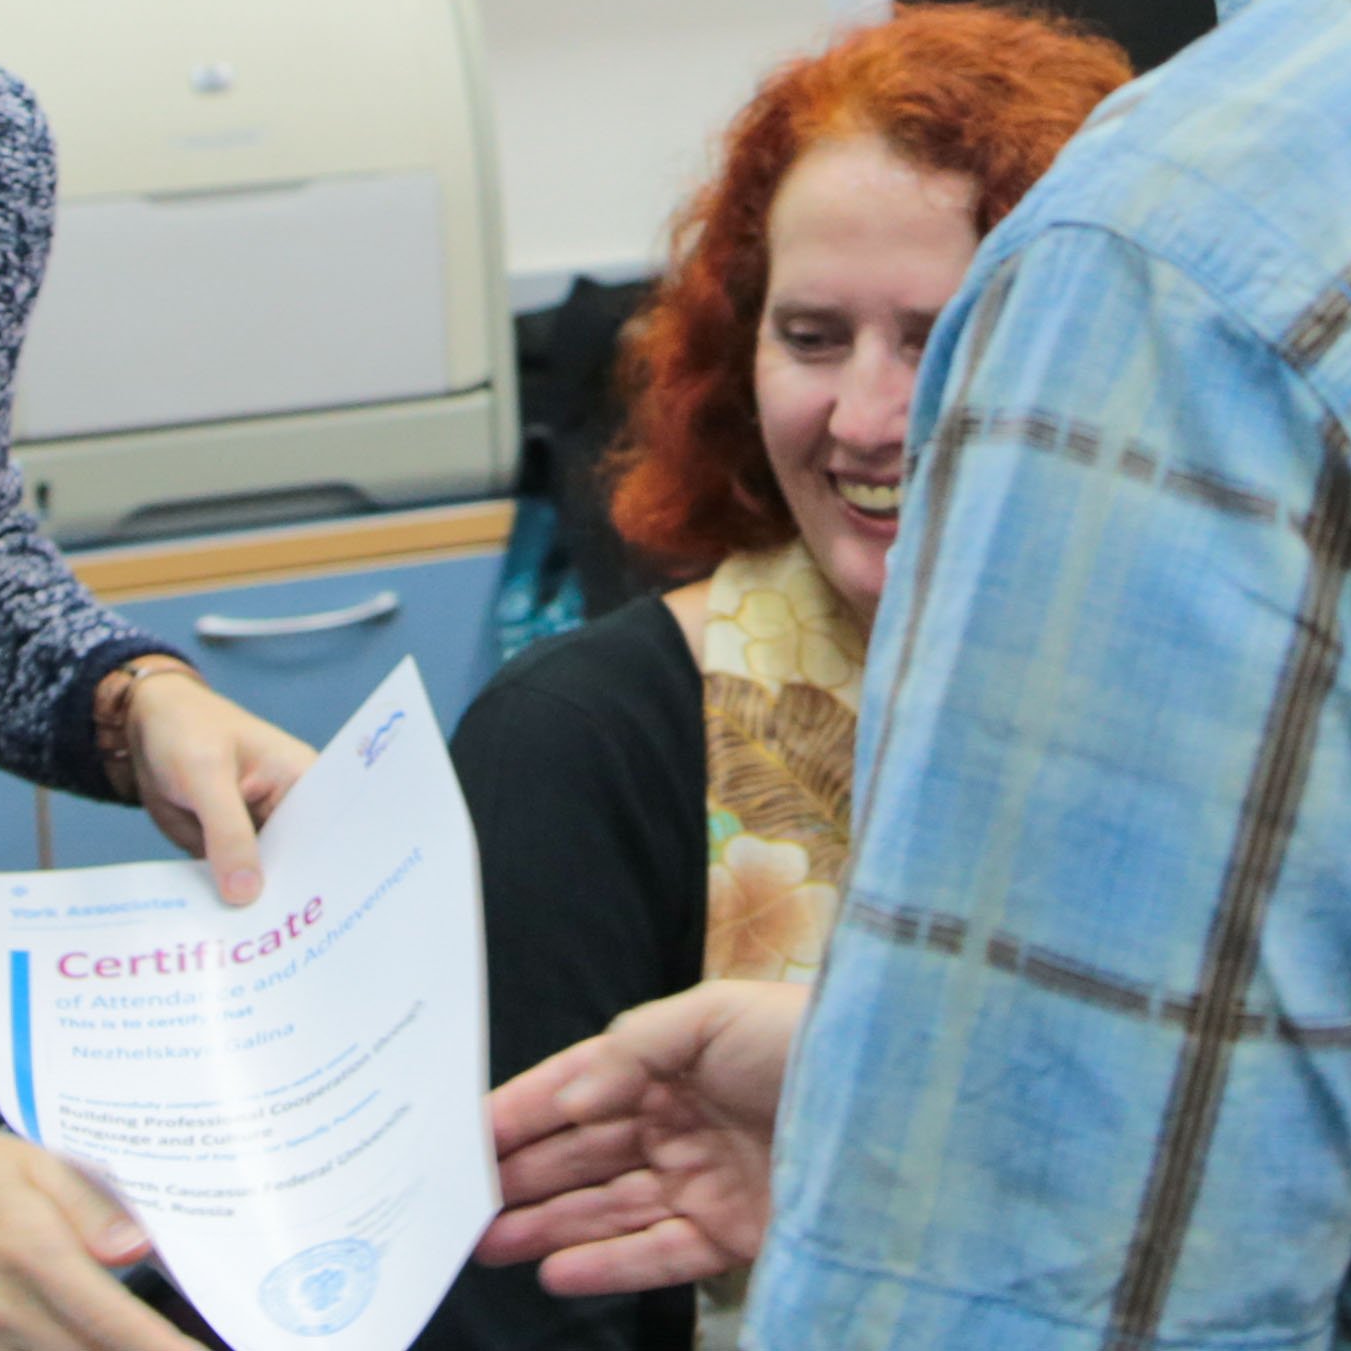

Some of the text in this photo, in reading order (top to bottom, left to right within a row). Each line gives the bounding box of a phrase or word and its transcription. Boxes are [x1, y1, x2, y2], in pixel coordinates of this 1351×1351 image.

[55, 845, 425, 1010] of Attendae and Achievement
[55, 894, 325, 981] Certificate
[58, 1016, 95, 1030] This
[122, 1016, 142, 1030] to
[58, 1104, 138, 1128] Building
[144, 1107, 265, 1129] Professial
[59, 1119, 151, 1145] Language
[157, 1134, 195, 1146] and
[200, 1127, 274, 1147] Culre
[165, 1184, 255, 1198] Caucasu
